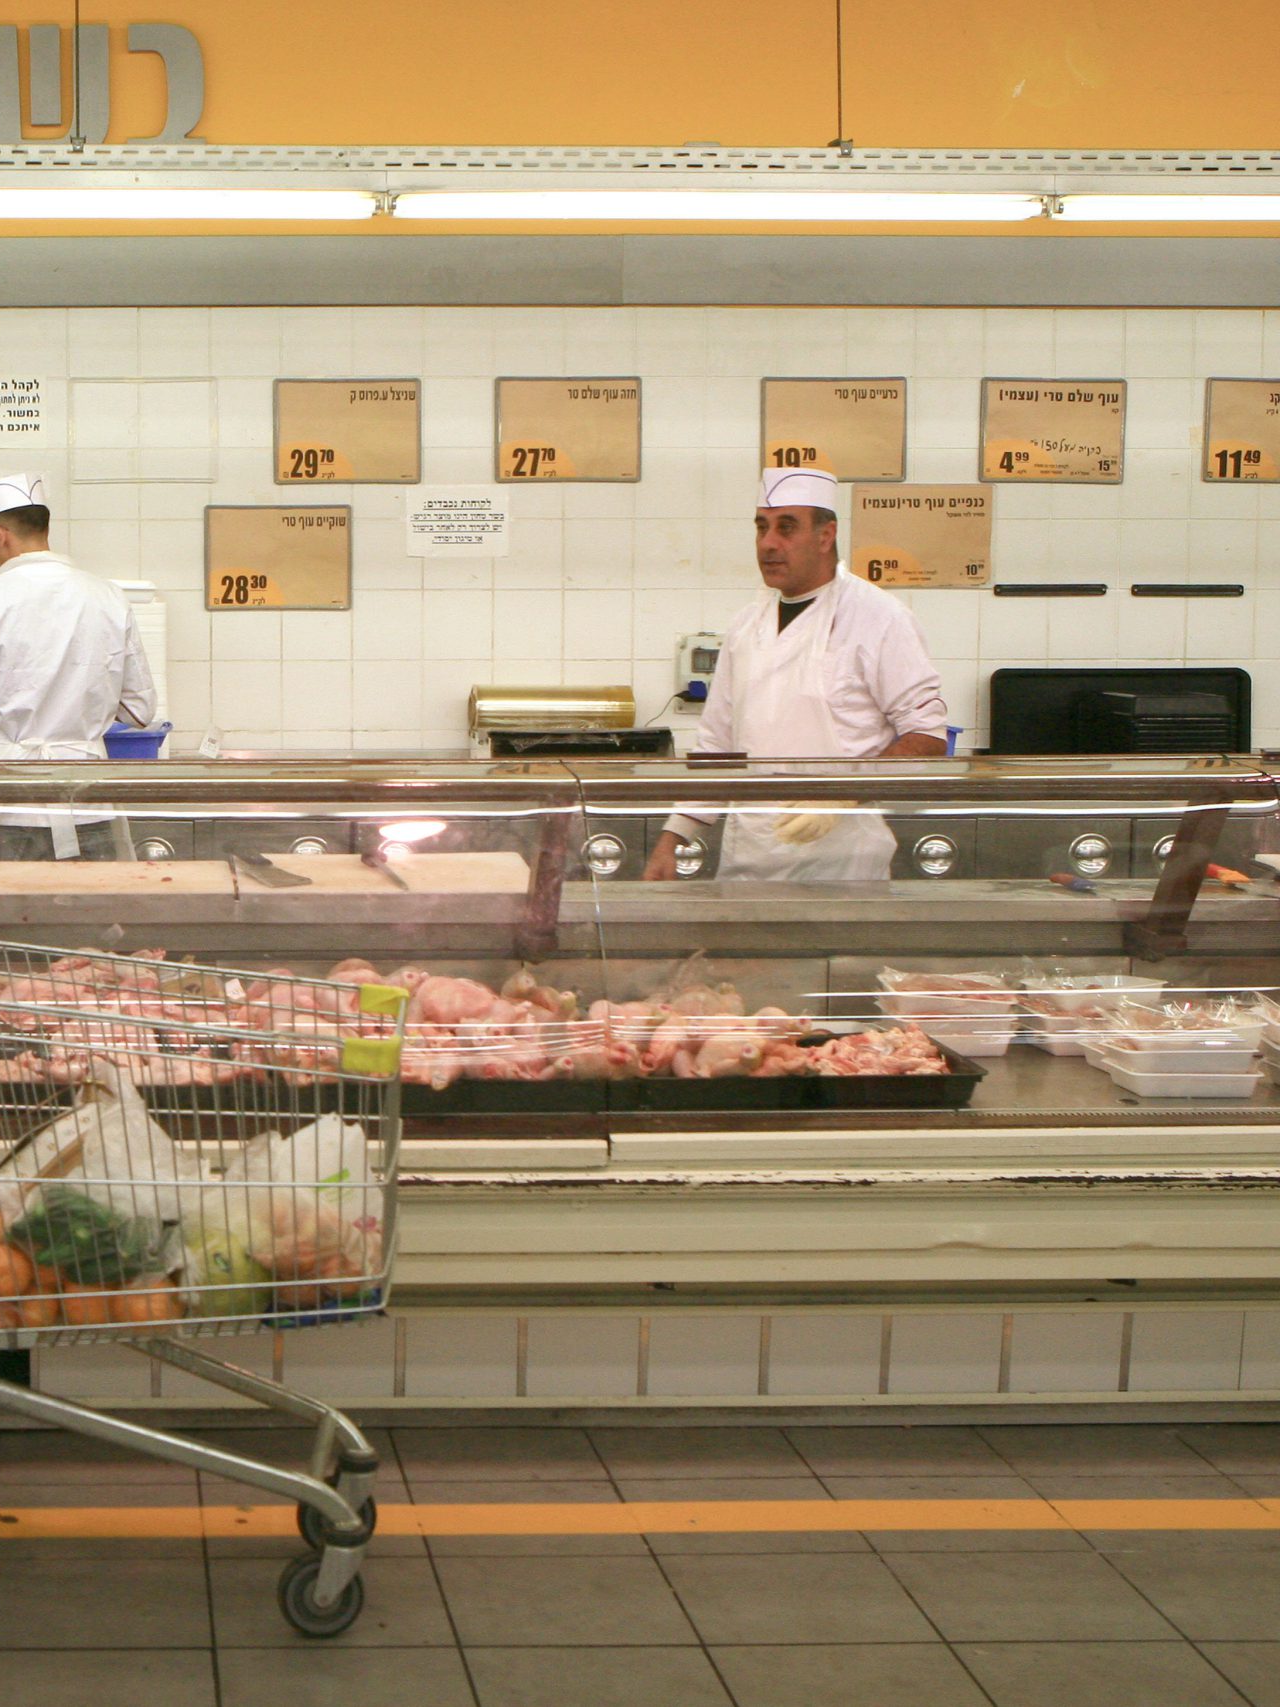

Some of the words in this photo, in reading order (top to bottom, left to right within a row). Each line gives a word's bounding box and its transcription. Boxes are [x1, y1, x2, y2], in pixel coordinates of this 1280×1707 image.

[11, 379, 40, 392] לקהל
[32, 393, 40, 404] לא
[390, 386, 416, 401] שניצל
[567, 388, 579, 399] טר
[581, 385, 601, 400] שלם
[602, 389, 618, 403] עוף
[620, 389, 637, 400] חזה
[834, 388, 849, 400] טרי
[851, 389, 867, 403] עוף
[869, 389, 898, 400] כרעיים
[1043, 391, 1063, 402] טרי
[1067, 389, 1094, 403] שלם
[18, 396, 30, 406] ניתן
[1098, 393, 1119, 406] עוף
[7, 423, 40, 432] איתכם
[801, 448, 817, 461] 70
[290, 449, 318, 478] 29
[319, 449, 335, 463] 70
[512, 448, 541, 477] 27
[540, 448, 556, 461] 70
[1000, 451, 1014, 474] 4
[1014, 452, 1030, 462] 99
[1098, 460, 1110, 472] 15
[1215, 449, 1242, 478] 11
[1243, 450, 1261, 464] 49
[460, 498, 491, 508] לקוחות
[924, 498, 945, 511] עוף
[948, 498, 985, 508] כנפיים
[282, 516, 296, 527] טרי
[298, 516, 314, 530] עוף
[316, 516, 346, 530] שוקיים
[867, 560, 883, 582] 6
[884, 560, 899, 569] 90
[965, 564, 977, 576] 10
[221, 575, 249, 604] 28
[250, 575, 267, 589] 30
